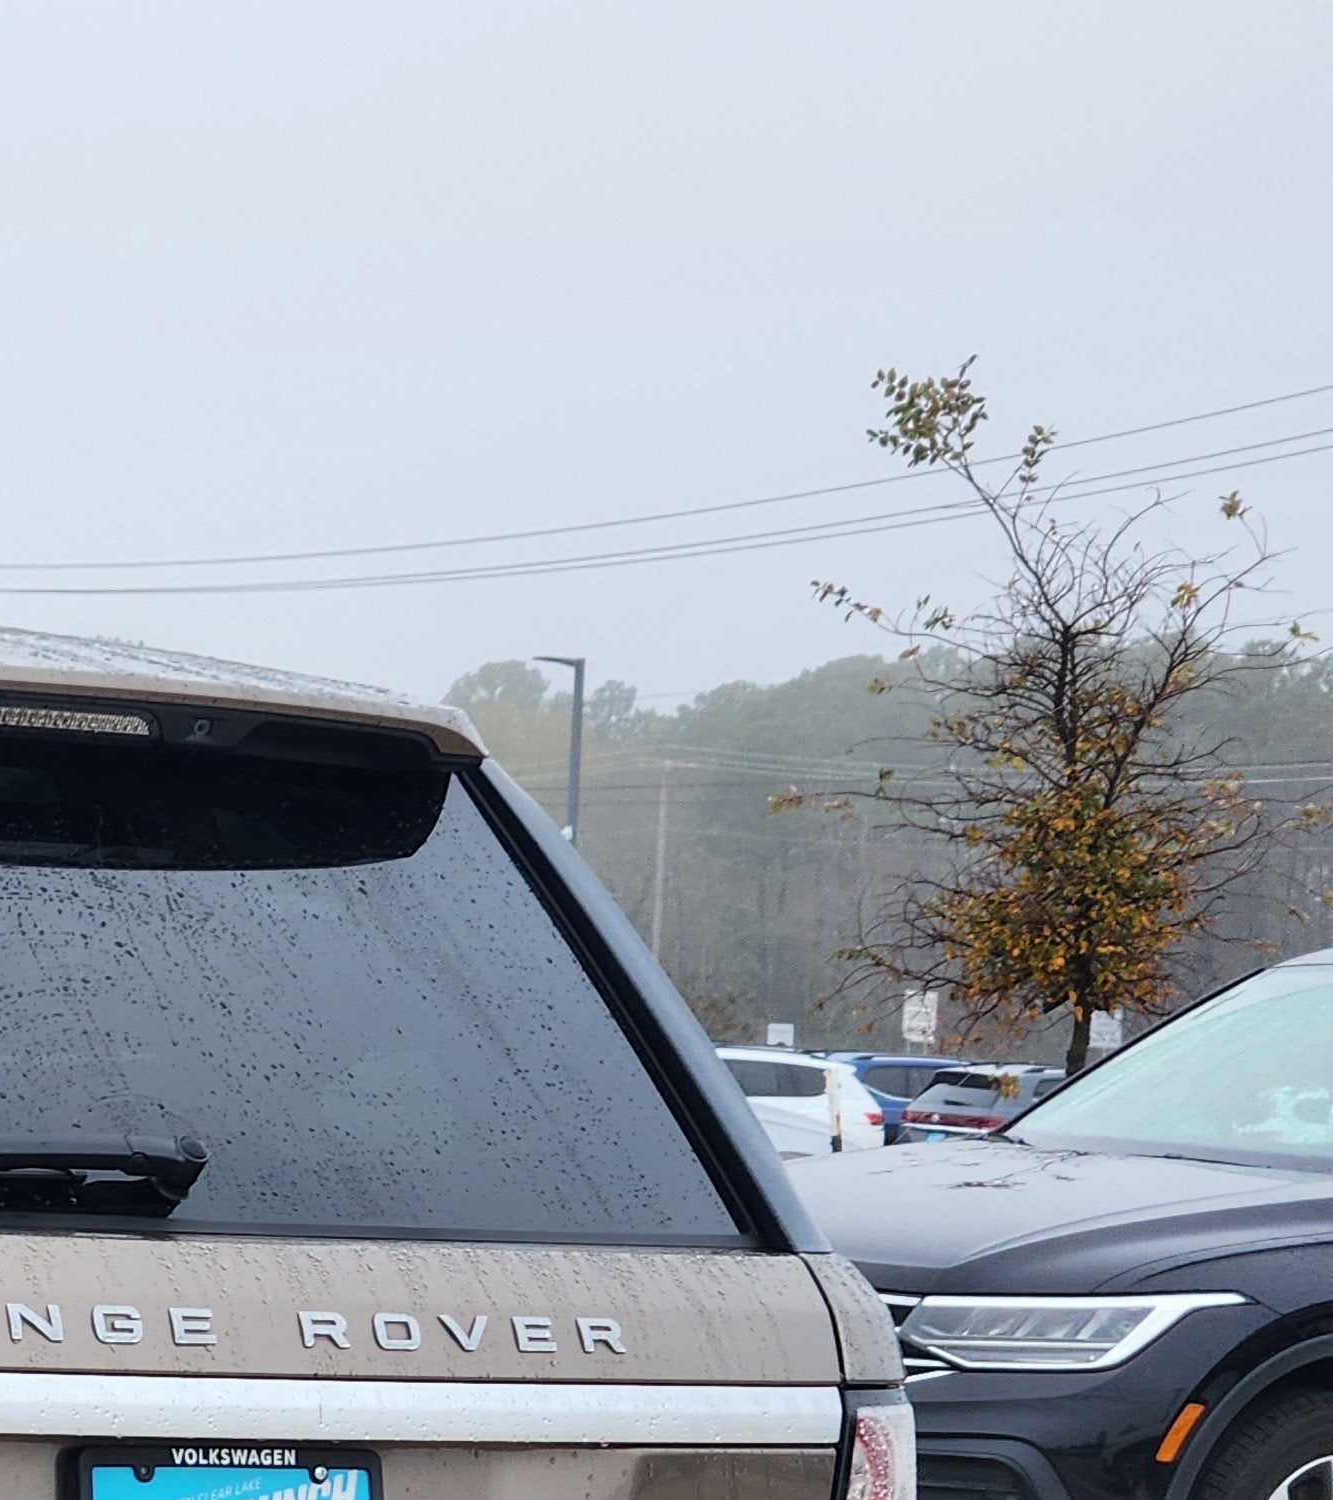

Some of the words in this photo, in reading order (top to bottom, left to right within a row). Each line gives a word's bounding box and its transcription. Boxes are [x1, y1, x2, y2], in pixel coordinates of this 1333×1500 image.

[298, 1310, 627, 1354] ROVER
[171, 1448, 297, 1466] VOLKSWAGEN
[235, 1477, 262, 1496] LAKE
